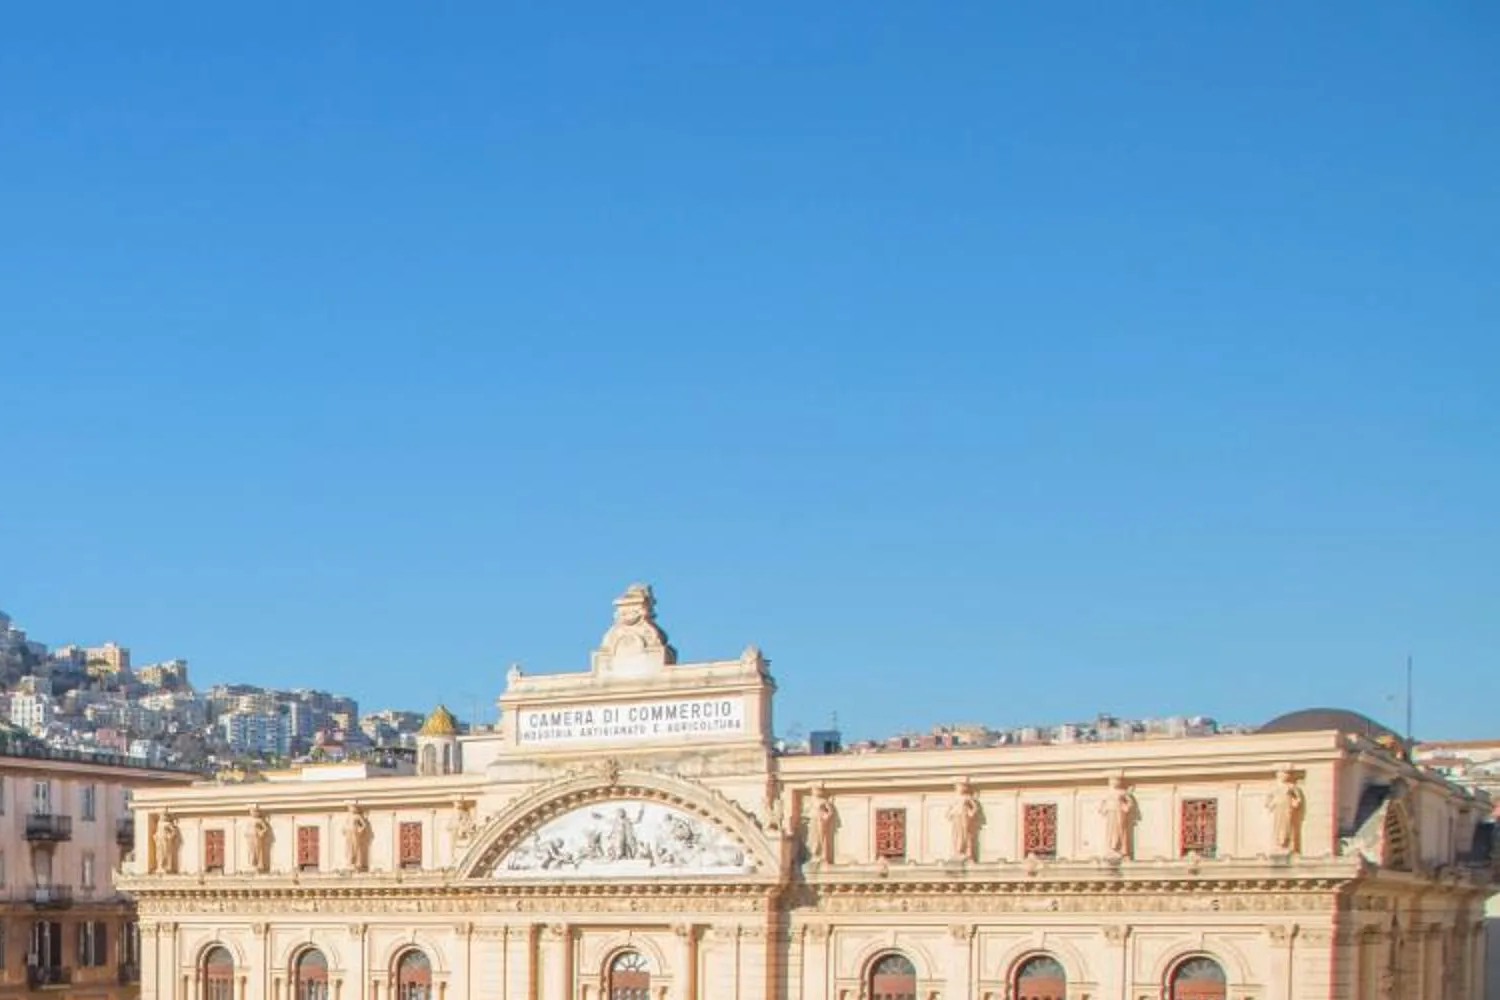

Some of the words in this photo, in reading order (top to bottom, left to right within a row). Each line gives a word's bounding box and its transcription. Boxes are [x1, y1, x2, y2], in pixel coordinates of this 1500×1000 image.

[530, 709, 593, 729] CAMERA
[603, 703, 619, 724] DI
[629, 701, 732, 722] COMMERCIO
